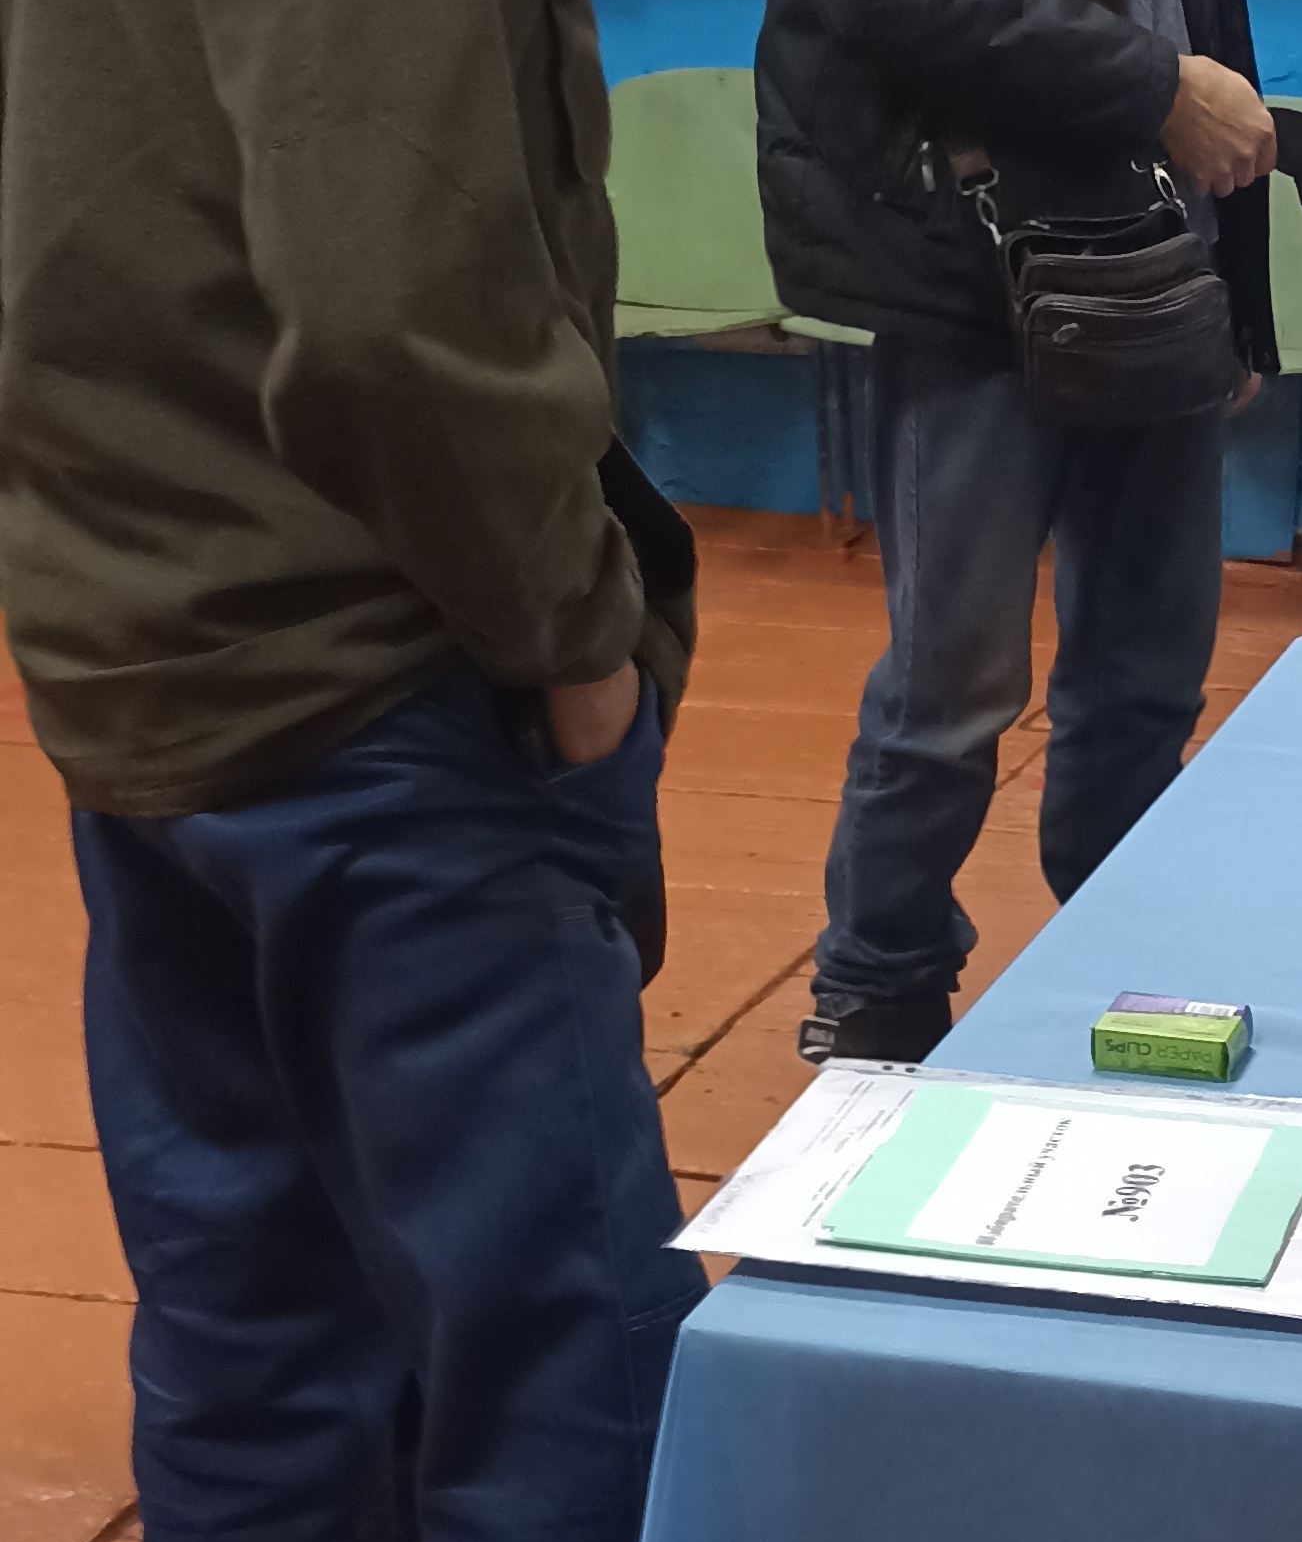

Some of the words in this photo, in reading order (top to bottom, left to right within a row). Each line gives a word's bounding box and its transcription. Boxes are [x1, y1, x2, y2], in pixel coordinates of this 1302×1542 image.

[1104, 1038, 1152, 1056] CLIPS
[1156, 1045, 1212, 1064] PAPER
[1101, 1163, 1166, 1223] №903
